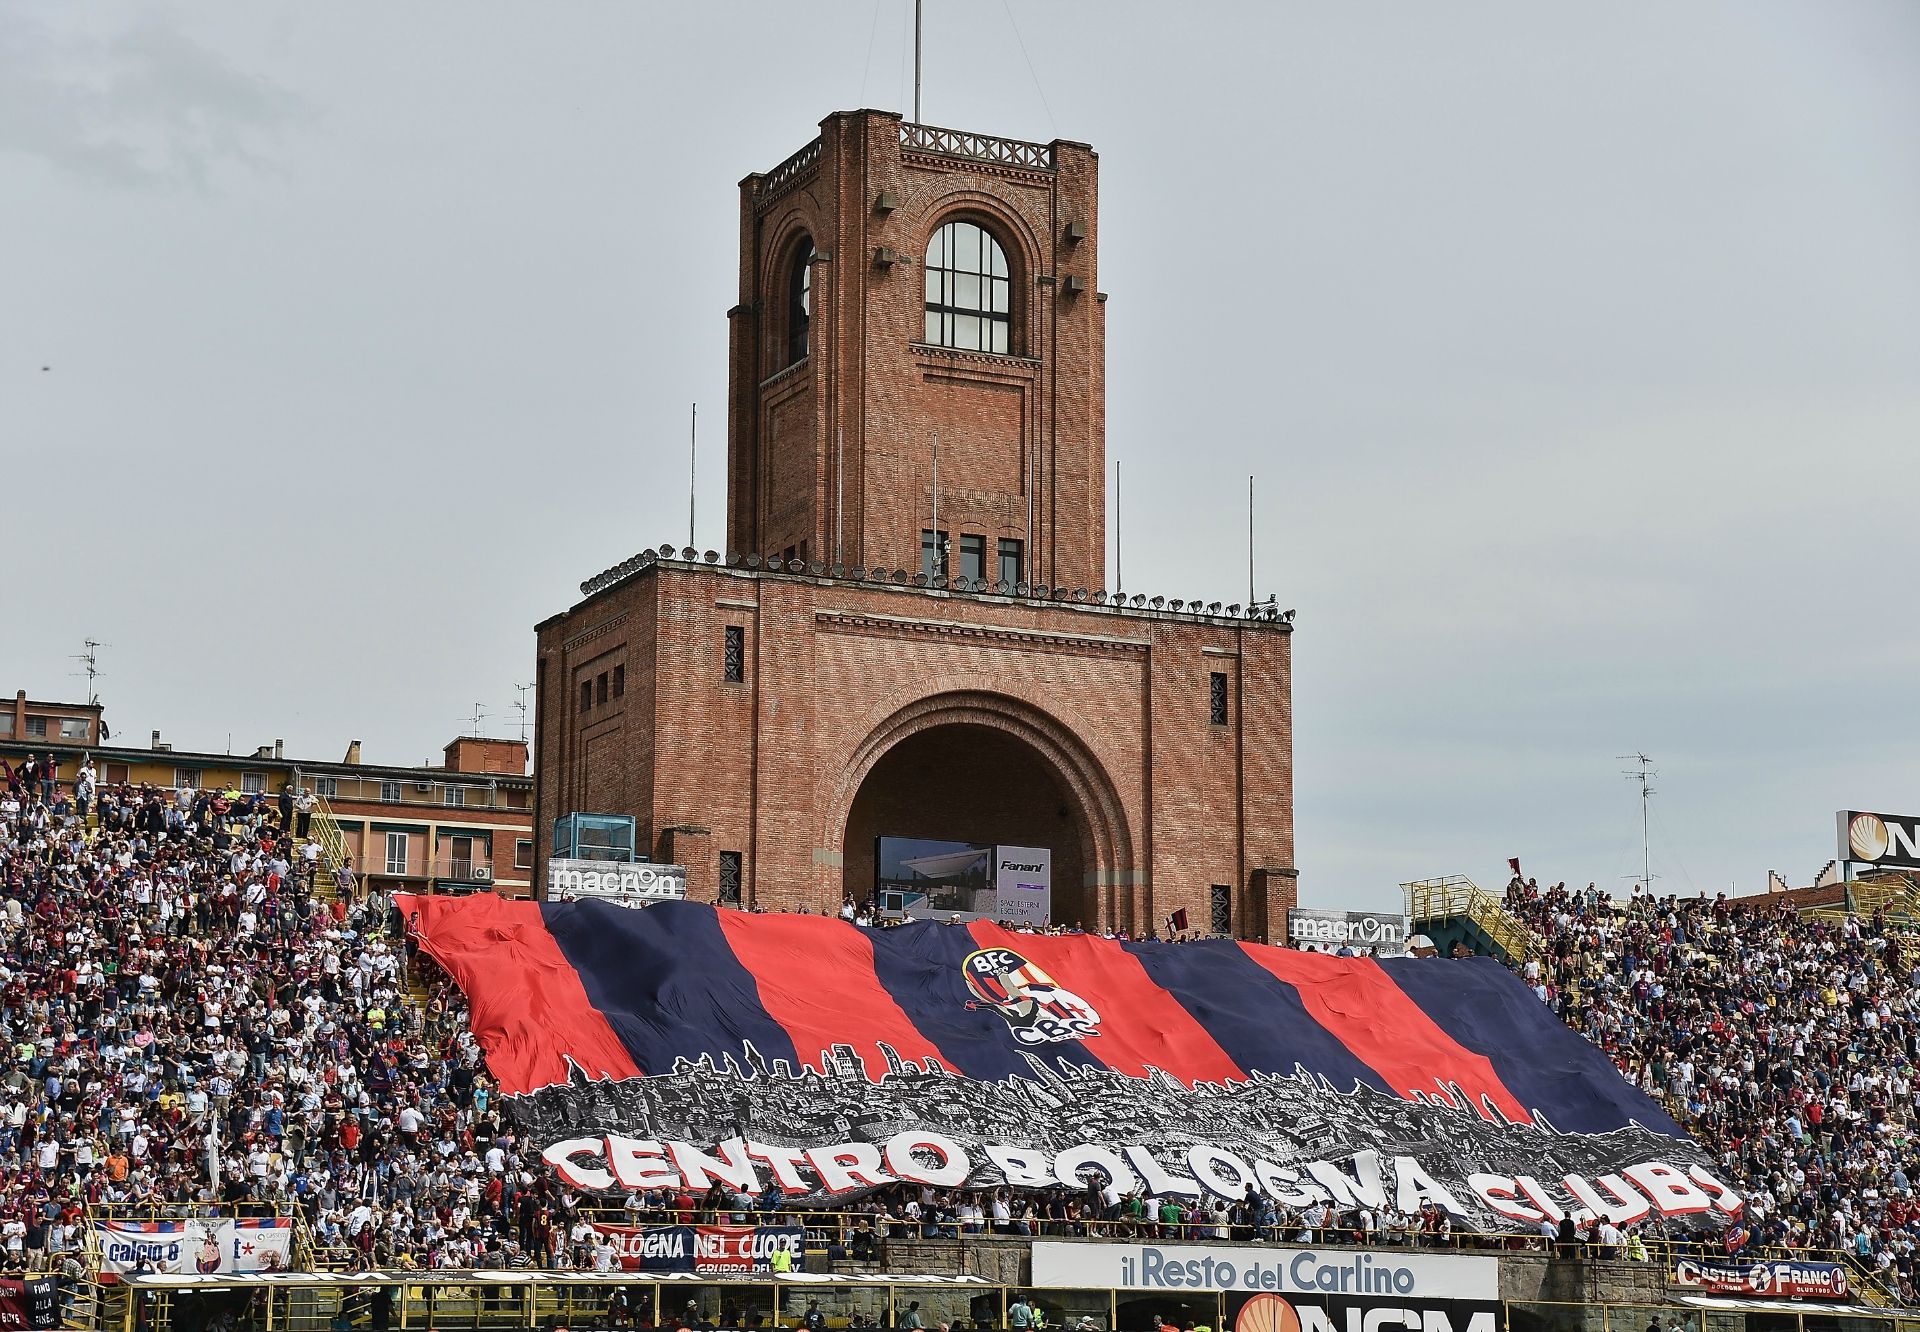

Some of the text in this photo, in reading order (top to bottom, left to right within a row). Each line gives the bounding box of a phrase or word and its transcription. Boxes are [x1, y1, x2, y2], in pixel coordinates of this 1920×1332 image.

[554, 869, 676, 895] macron
[1293, 917, 1396, 943] macron
[973, 952, 1014, 972] BFC
[1013, 1019, 1100, 1044] CBC
[542, 1130, 970, 1195] CENTRO
[984, 1142, 1470, 1219] BOLOGNA
[541, 1215, 547, 1225] 8
[109, 1240, 163, 1262] calcio
[694, 1233, 729, 1259] NEL
[1121, 1247, 1414, 1294] il Resto del Carlino
[1677, 1261, 1744, 1286] CASTEL
